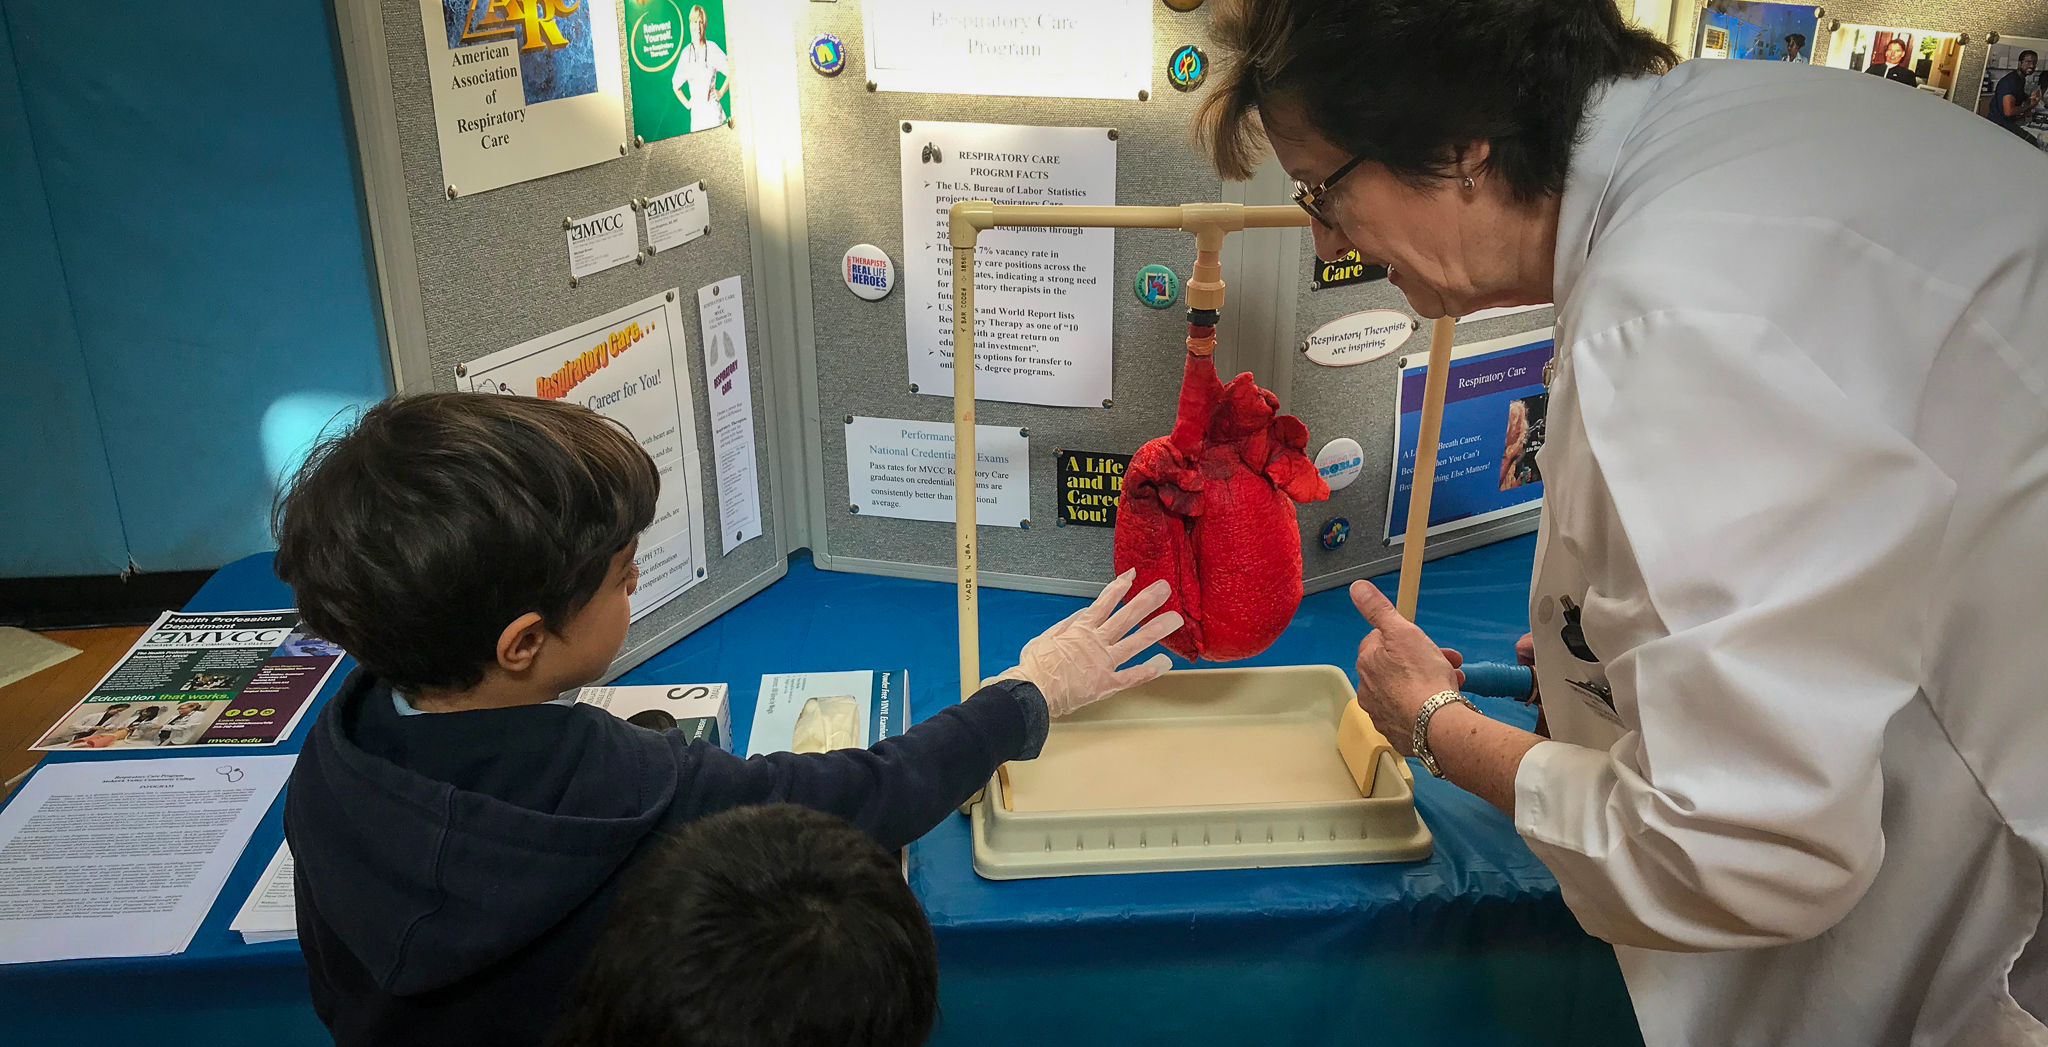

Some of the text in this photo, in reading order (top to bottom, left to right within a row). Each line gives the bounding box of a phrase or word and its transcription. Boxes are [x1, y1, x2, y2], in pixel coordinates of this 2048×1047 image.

[452, 46, 510, 67] American
[968, 38, 1041, 60] Program
[451, 66, 518, 90] Association
[485, 89, 497, 105] of
[457, 108, 526, 133] Respiratory
[481, 133, 510, 150] Care
[959, 151, 1060, 164] RESPIRATORY CARE
[970, 167, 1049, 180] PROGRM FACTS
[936, 181, 1087, 197] The U.S. Bureau of Labor Statistics
[657, 189, 695, 215] MVCC
[582, 213, 624, 238] MVCC
[1049, 227, 1083, 236] through
[979, 246, 1059, 259] 7% vacancy rate in
[852, 256, 886, 267] THERAPISTS
[1005, 261, 1041, 270] positions
[1044, 264, 1070, 272] across
[1072, 264, 1086, 272] the
[852, 264, 886, 277] REAL LIFE
[995, 271, 1037, 283] indicating
[1047, 276, 1074, 285] strong
[1076, 277, 1096, 285] need
[1322, 264, 1363, 282] Care
[852, 273, 887, 288] HEROES
[937, 280, 949, 288] for
[1000, 284, 1040, 294] therapists
[1043, 286, 1051, 294] in
[1054, 287, 1066, 295] the
[981, 307, 996, 315] and
[999, 308, 1025, 317] World
[1027, 309, 1056, 319] Report
[1058, 311, 1075, 319] lists
[988, 318, 1023, 329] Therapy
[997, 332, 1018, 340] great
[1021, 333, 1047, 341] return
[1310, 322, 1406, 346] Respiratory Therapists
[1332, 339, 1386, 355] are inspiring
[983, 352, 1012, 362] options
[1014, 355, 1027, 363] for
[1029, 357, 1061, 366] transfer
[536, 341, 609, 401] Respiratory
[984, 365, 1055, 377] degree programs.
[1458, 366, 1527, 389] Respiratory Care
[588, 369, 661, 412] Career for You!
[642, 426, 674, 446] with heart and
[901, 429, 955, 442] Performanc
[656, 449, 665, 459] and
[869, 445, 1009, 464] National Exams
[1402, 450, 1408, 459] A
[1448, 455, 1462, 464] You
[870, 461, 885, 470] Pass
[919, 465, 945, 474] MVCC
[991, 471, 1009, 479] Care
[1066, 456, 1124, 474] A Life
[1451, 461, 1491, 479] Else Matters!
[870, 474, 905, 482] graduates
[1066, 475, 1103, 490] and
[871, 488, 953, 500] consistently better than
[1067, 489, 1120, 507] Caree
[871, 500, 901, 509] average.
[1066, 505, 1107, 523] You!
[649, 553, 678, 570] information
[642, 571, 669, 589] respiratory
[162, 622, 236, 631] Department
[168, 615, 283, 624] Health Professions
[175, 630, 282, 644] MVCC
[881, 672, 891, 689] Powder
[88, 694, 156, 703] Education
[666, 687, 710, 700] S
[880, 689, 890, 700] Free
